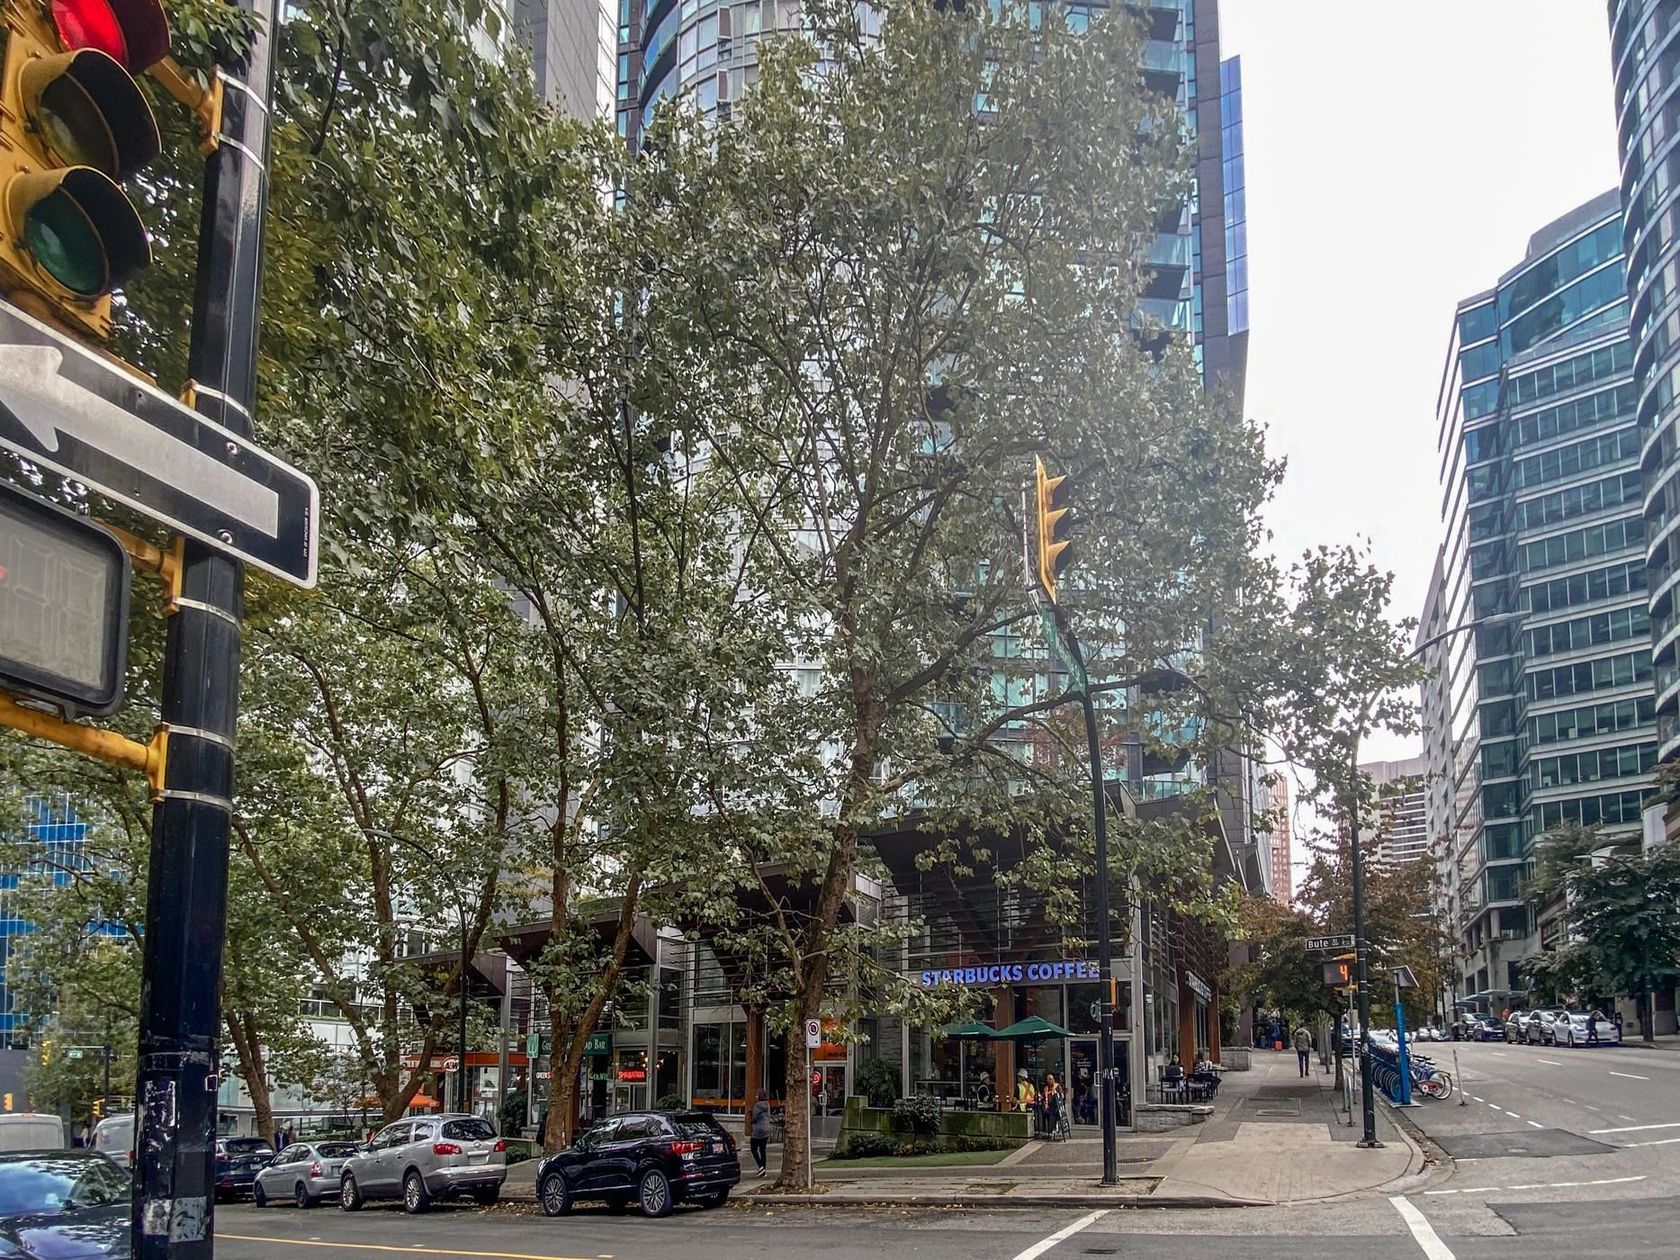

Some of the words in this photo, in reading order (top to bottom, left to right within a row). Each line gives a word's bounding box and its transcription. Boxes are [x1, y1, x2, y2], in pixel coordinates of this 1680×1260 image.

[1308, 939, 1329, 949] Bute
[922, 965, 1023, 986] STARBUCKS
[1027, 961, 1100, 980] COFFEE
[1340, 965, 1348, 980] 4
